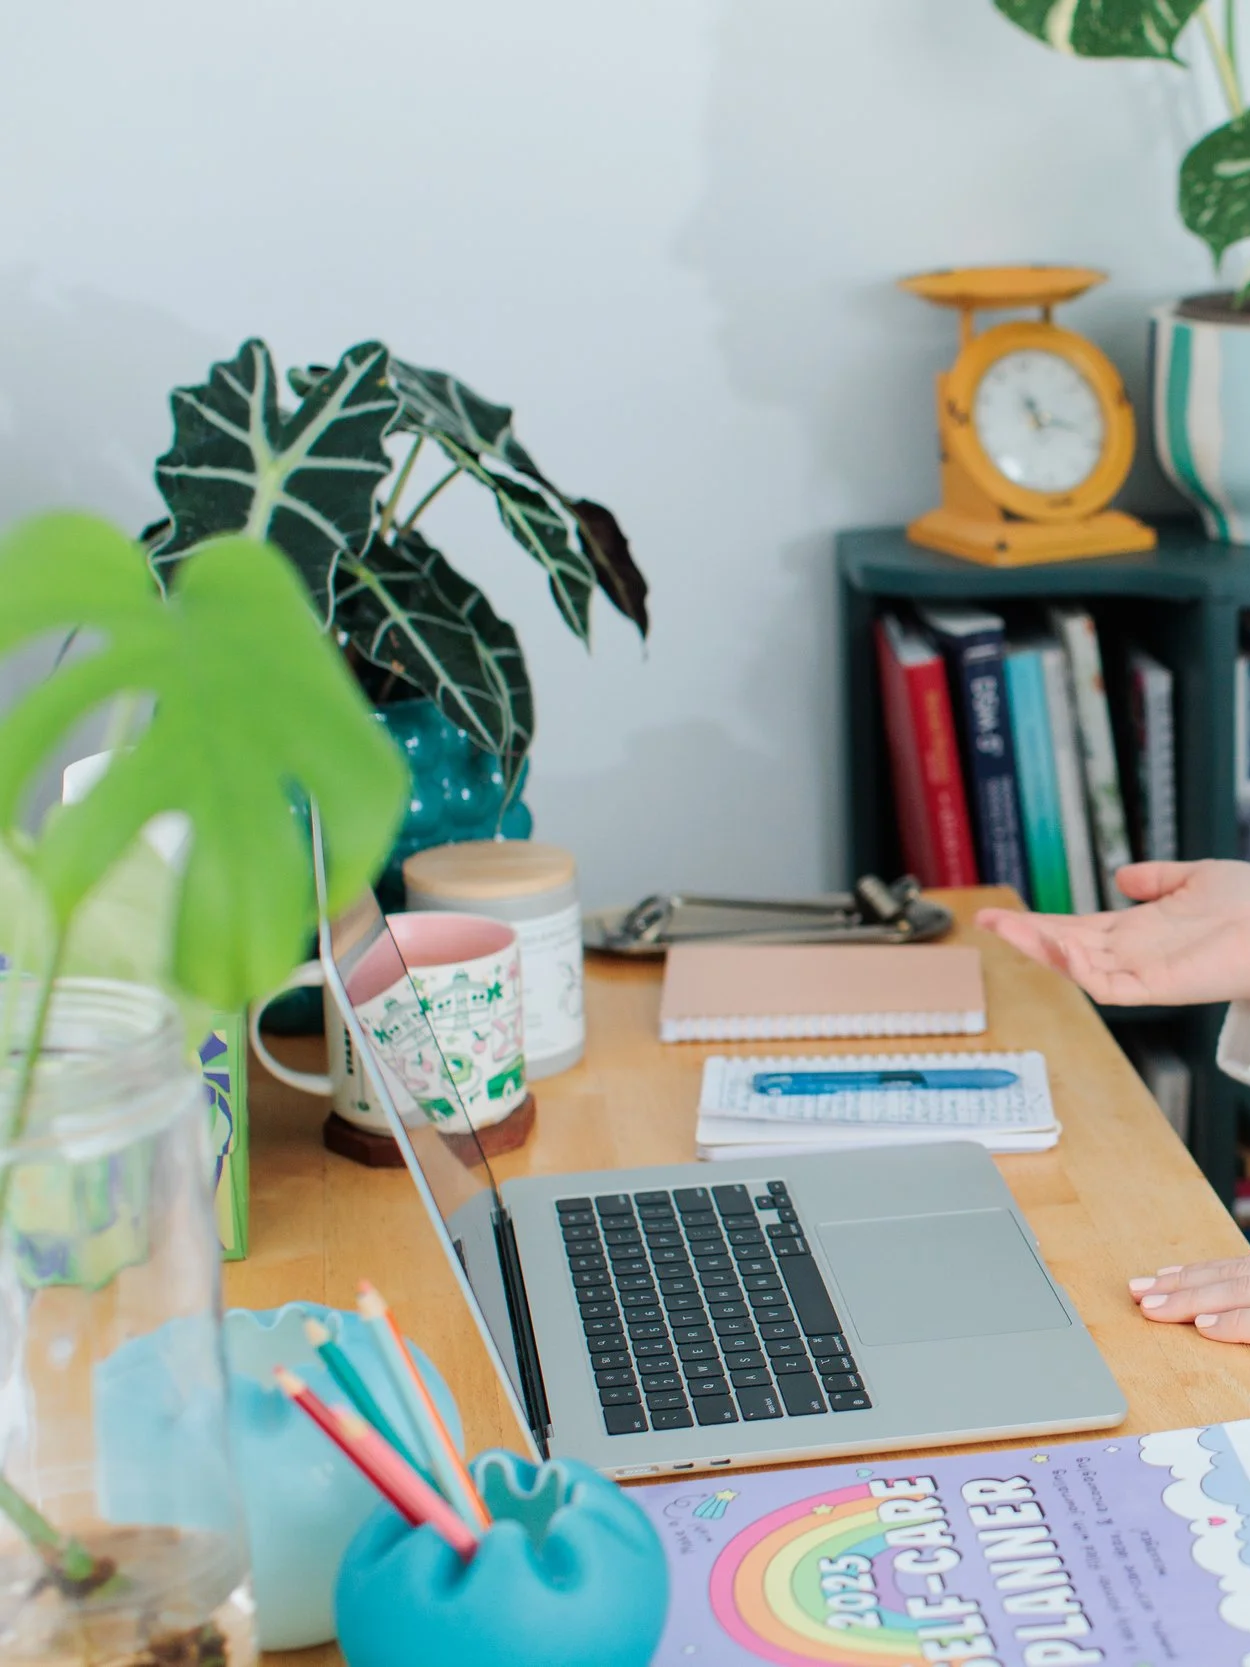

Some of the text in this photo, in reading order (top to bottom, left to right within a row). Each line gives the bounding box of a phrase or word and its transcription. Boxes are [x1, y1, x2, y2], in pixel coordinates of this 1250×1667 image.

[1052, 1469, 1085, 1516] journaling
[1075, 1456, 1108, 1513] encouraging
[819, 1554, 884, 1630] 2025
[961, 1475, 1106, 1667] PLANNER
